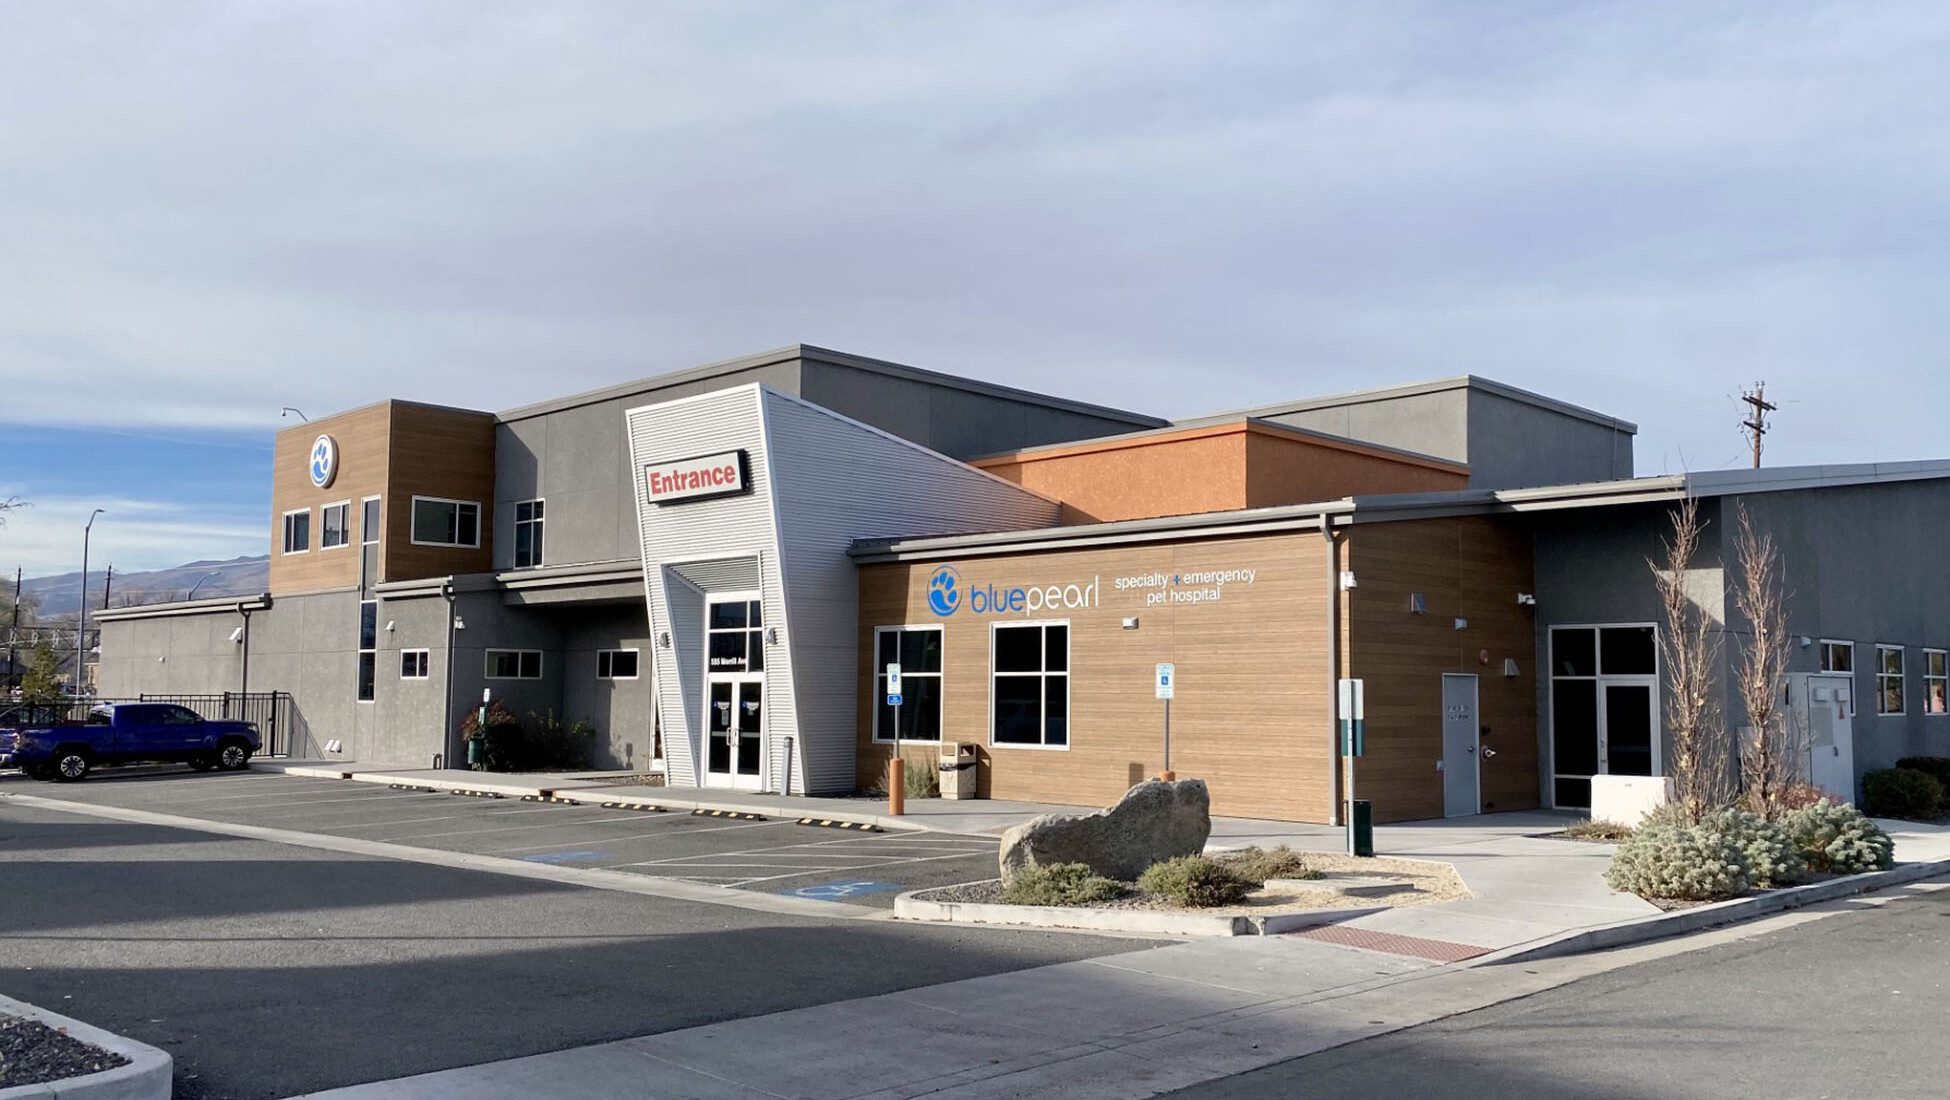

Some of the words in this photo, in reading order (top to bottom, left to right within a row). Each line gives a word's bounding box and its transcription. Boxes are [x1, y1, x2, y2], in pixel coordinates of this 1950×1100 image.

[650, 465, 736, 495] Entrance
[1114, 572, 1168, 591] specialty
[1183, 569, 1256, 587] emergency
[971, 575, 1099, 618] bluepearl
[1146, 590, 1167, 606] pet
[1170, 586, 1220, 604] hospital
